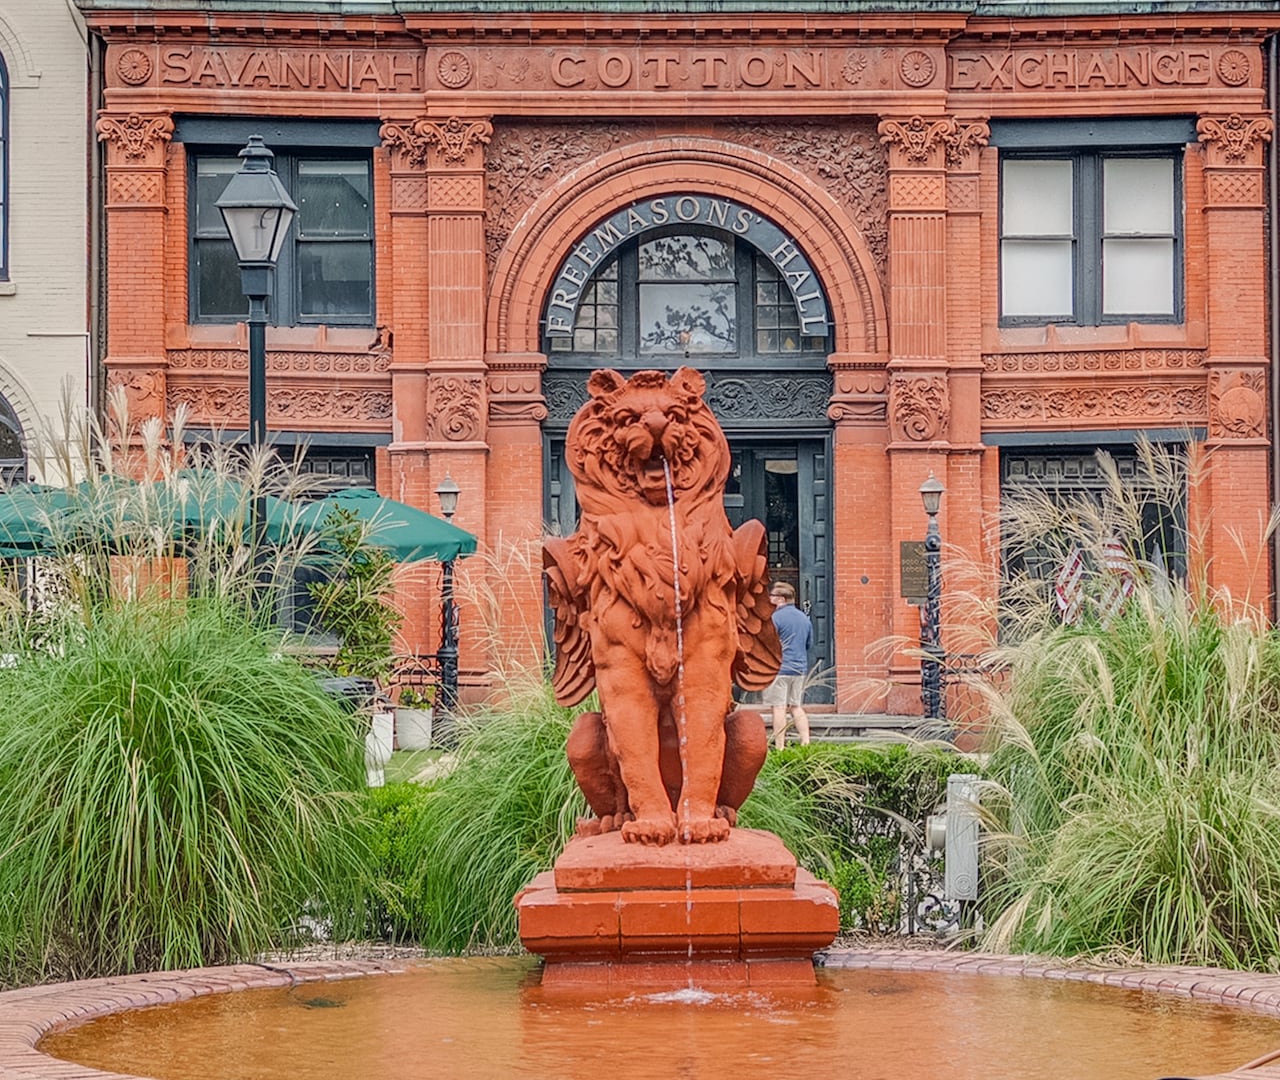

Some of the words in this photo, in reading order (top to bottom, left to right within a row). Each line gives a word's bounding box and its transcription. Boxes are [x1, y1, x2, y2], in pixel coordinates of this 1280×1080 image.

[163, 49, 421, 90] SAVANNAH
[551, 51, 822, 88] COTTON
[949, 50, 1210, 89] EXCHANGE
[547, 196, 762, 336] FREEMASONS'
[769, 238, 827, 334] HALL
